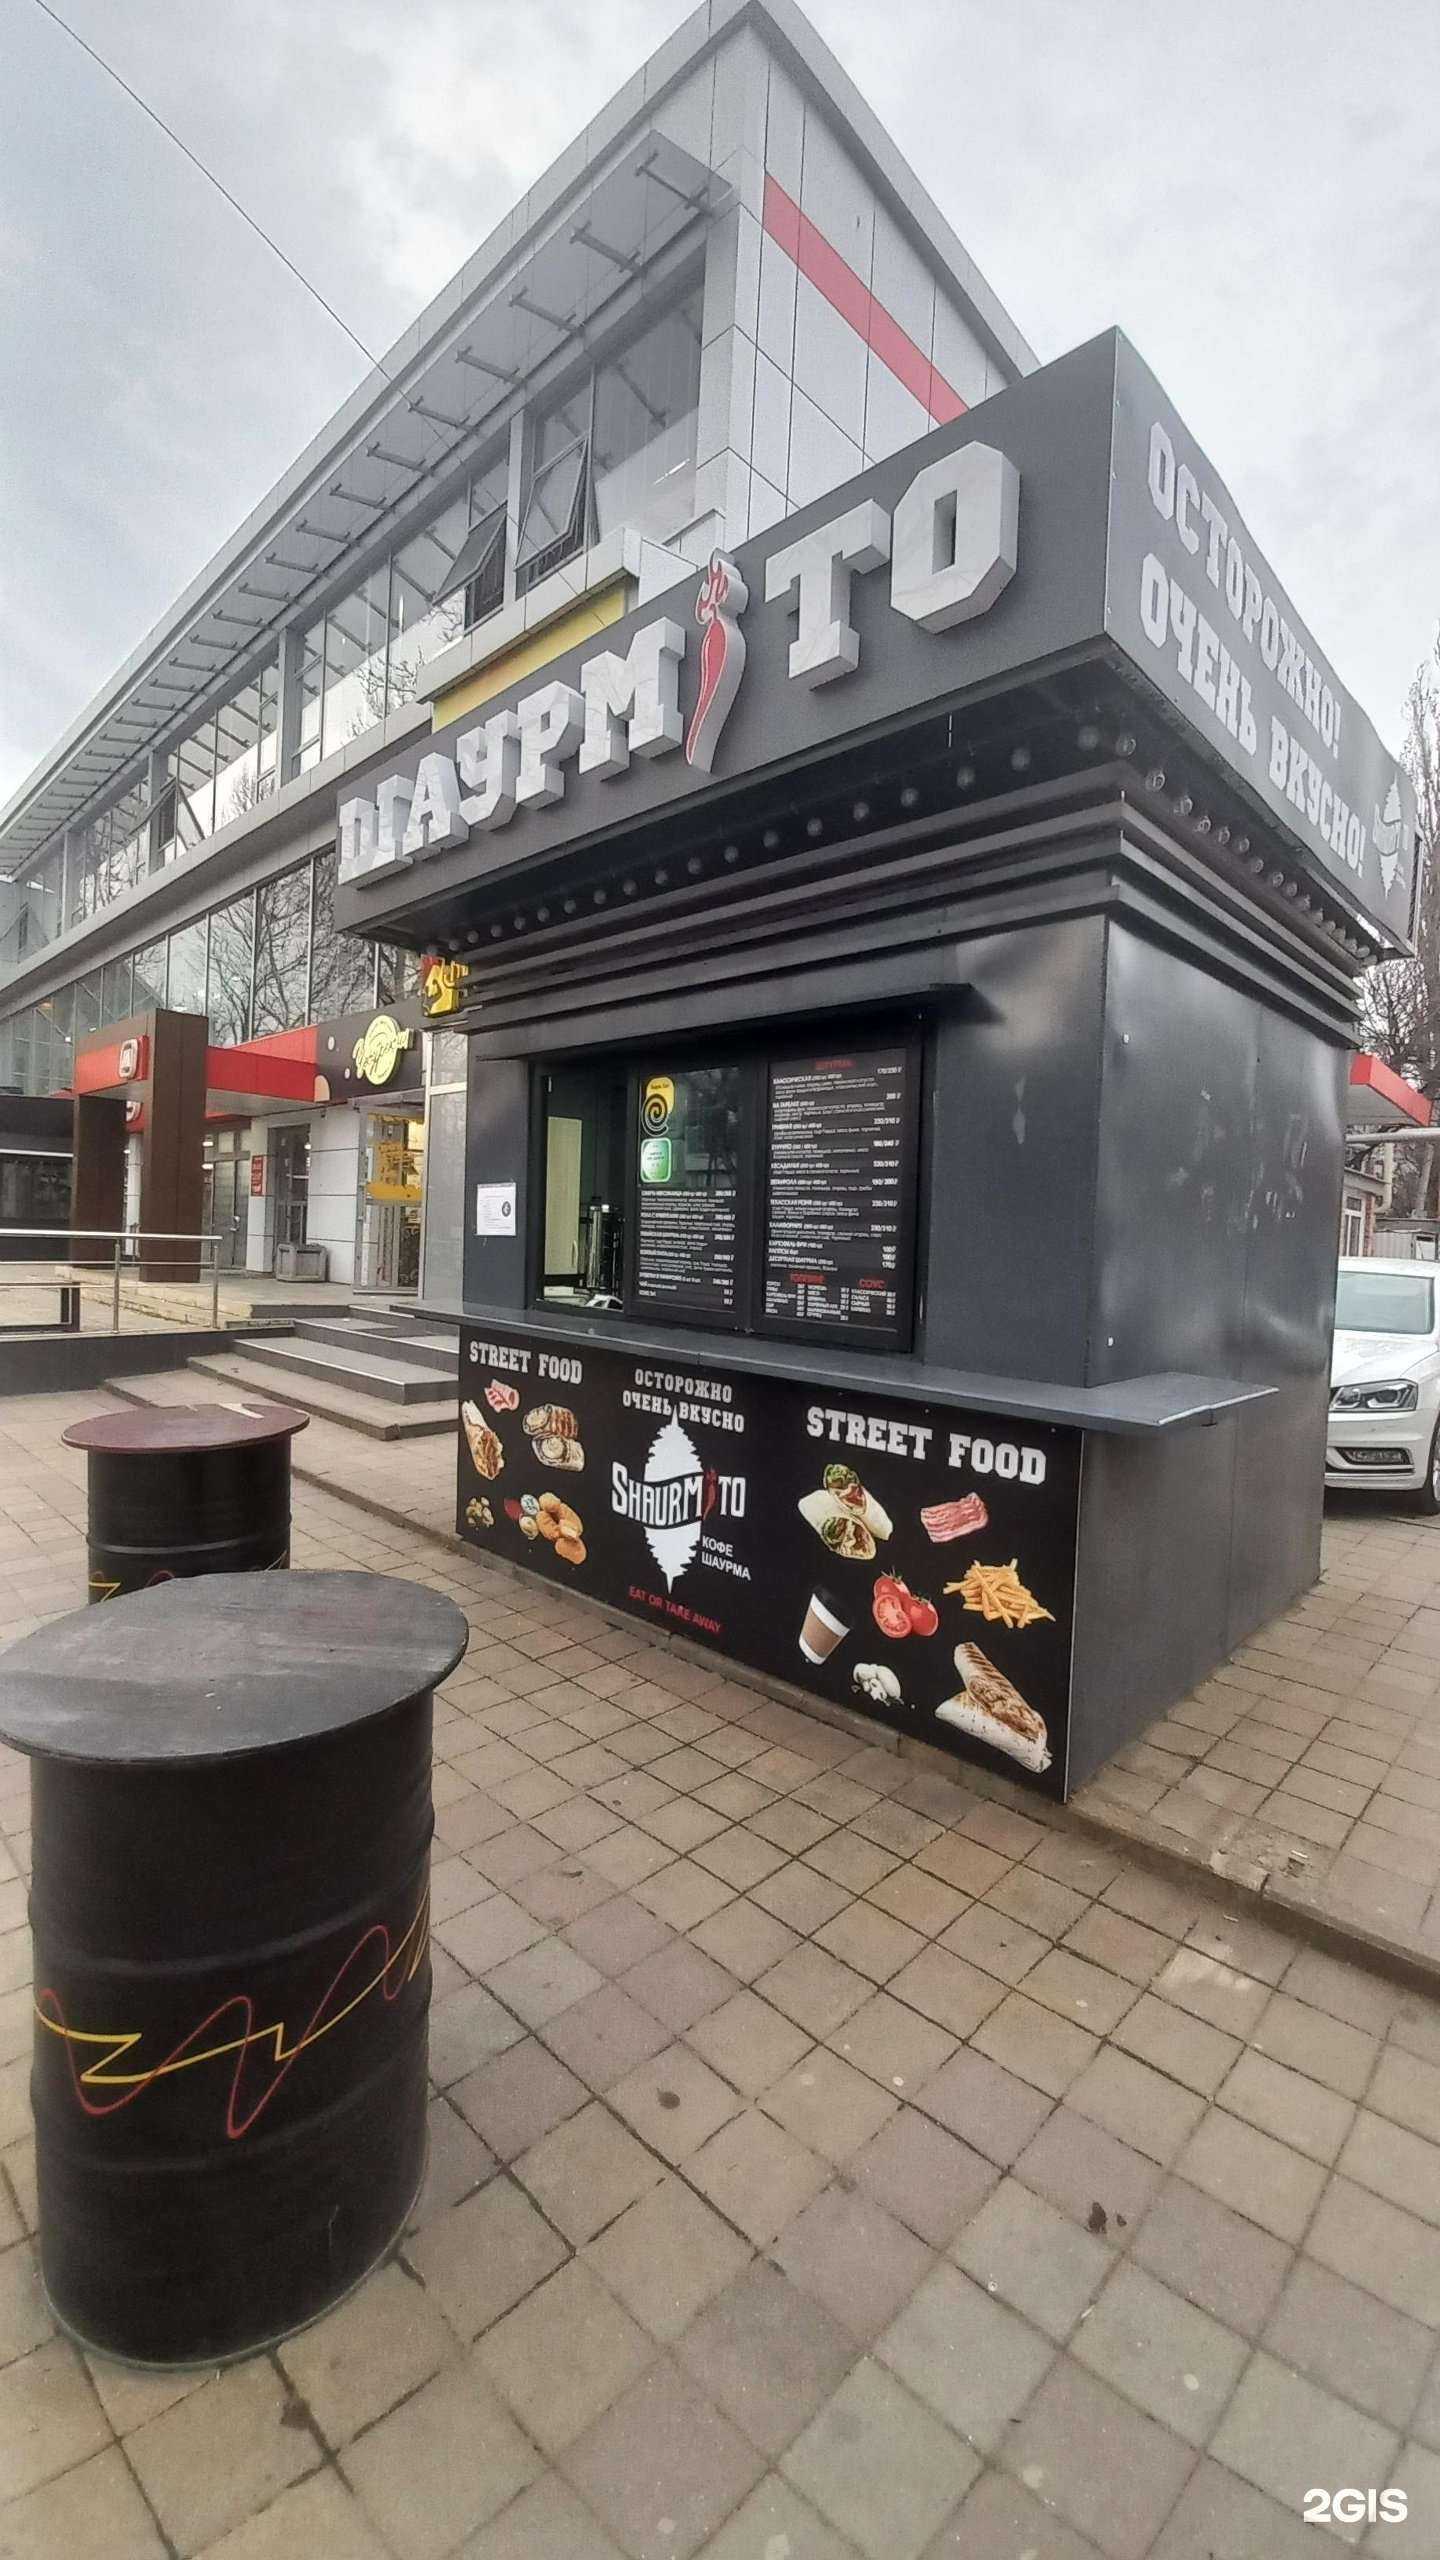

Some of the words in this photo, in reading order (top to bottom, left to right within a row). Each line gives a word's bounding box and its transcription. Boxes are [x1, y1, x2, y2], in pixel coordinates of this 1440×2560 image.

[1147, 420, 1342, 760] ОСТОРОЖНО!
[1139, 552, 1257, 757] ОЧЕНЬ
[1267, 714, 1367, 878] ВКУСНО!
[469, 1340, 532, 1374] STREET
[537, 1352, 584, 1385] FOOD
[634, 1367, 733, 1404] ОСТОРОЖНО
[622, 1389, 673, 1417] ОЧЕНЬ
[678, 1401, 745, 1433] ВКУСНО
[805, 1406, 933, 1461] STREET
[947, 1432, 1047, 1486] FOOD
[701, 1552, 752, 1581] ШАУРМА
[702, 1535, 734, 1558] КОФЕ
[629, 1585, 646, 1602] EAT
[648, 1593, 664, 1610] OR
[665, 1600, 691, 1622] TAKE
[692, 1612, 721, 1633] AWAY
